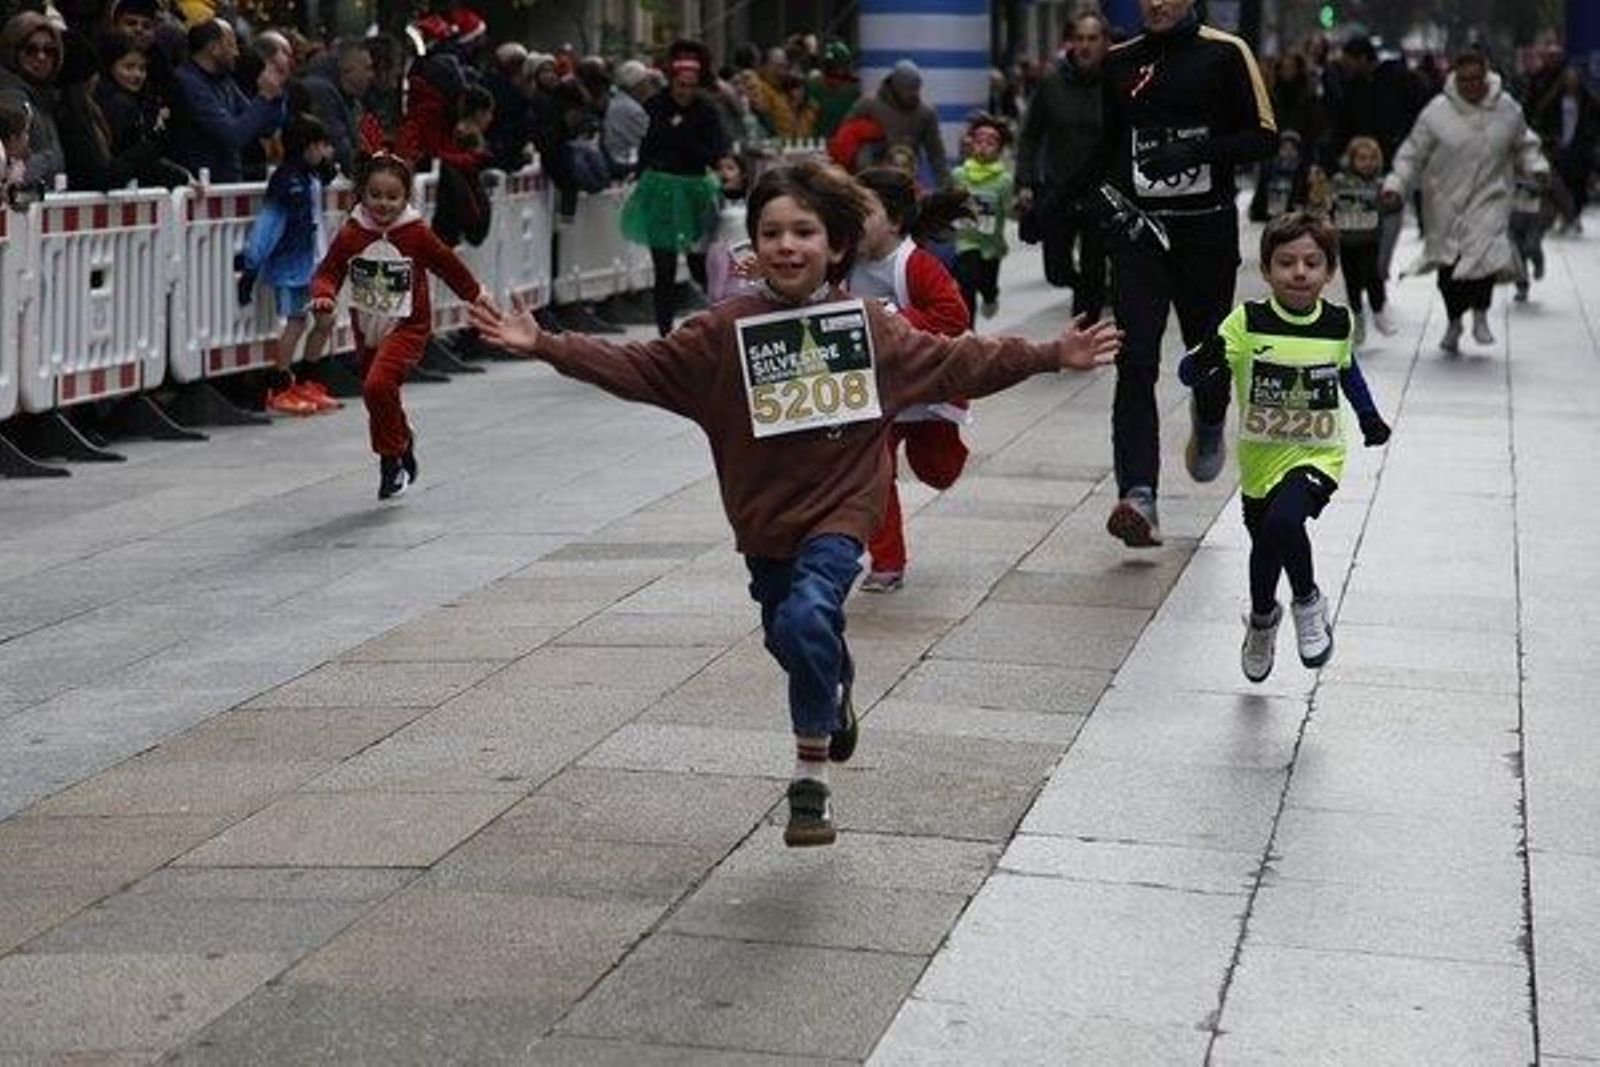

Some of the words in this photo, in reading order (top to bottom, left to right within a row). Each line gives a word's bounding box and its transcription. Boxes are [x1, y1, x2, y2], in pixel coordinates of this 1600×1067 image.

[748, 339, 787, 361] SAN
[751, 343, 840, 373] SILVESTRE
[752, 371, 869, 424] 5208
[1246, 406, 1335, 439] 5220
